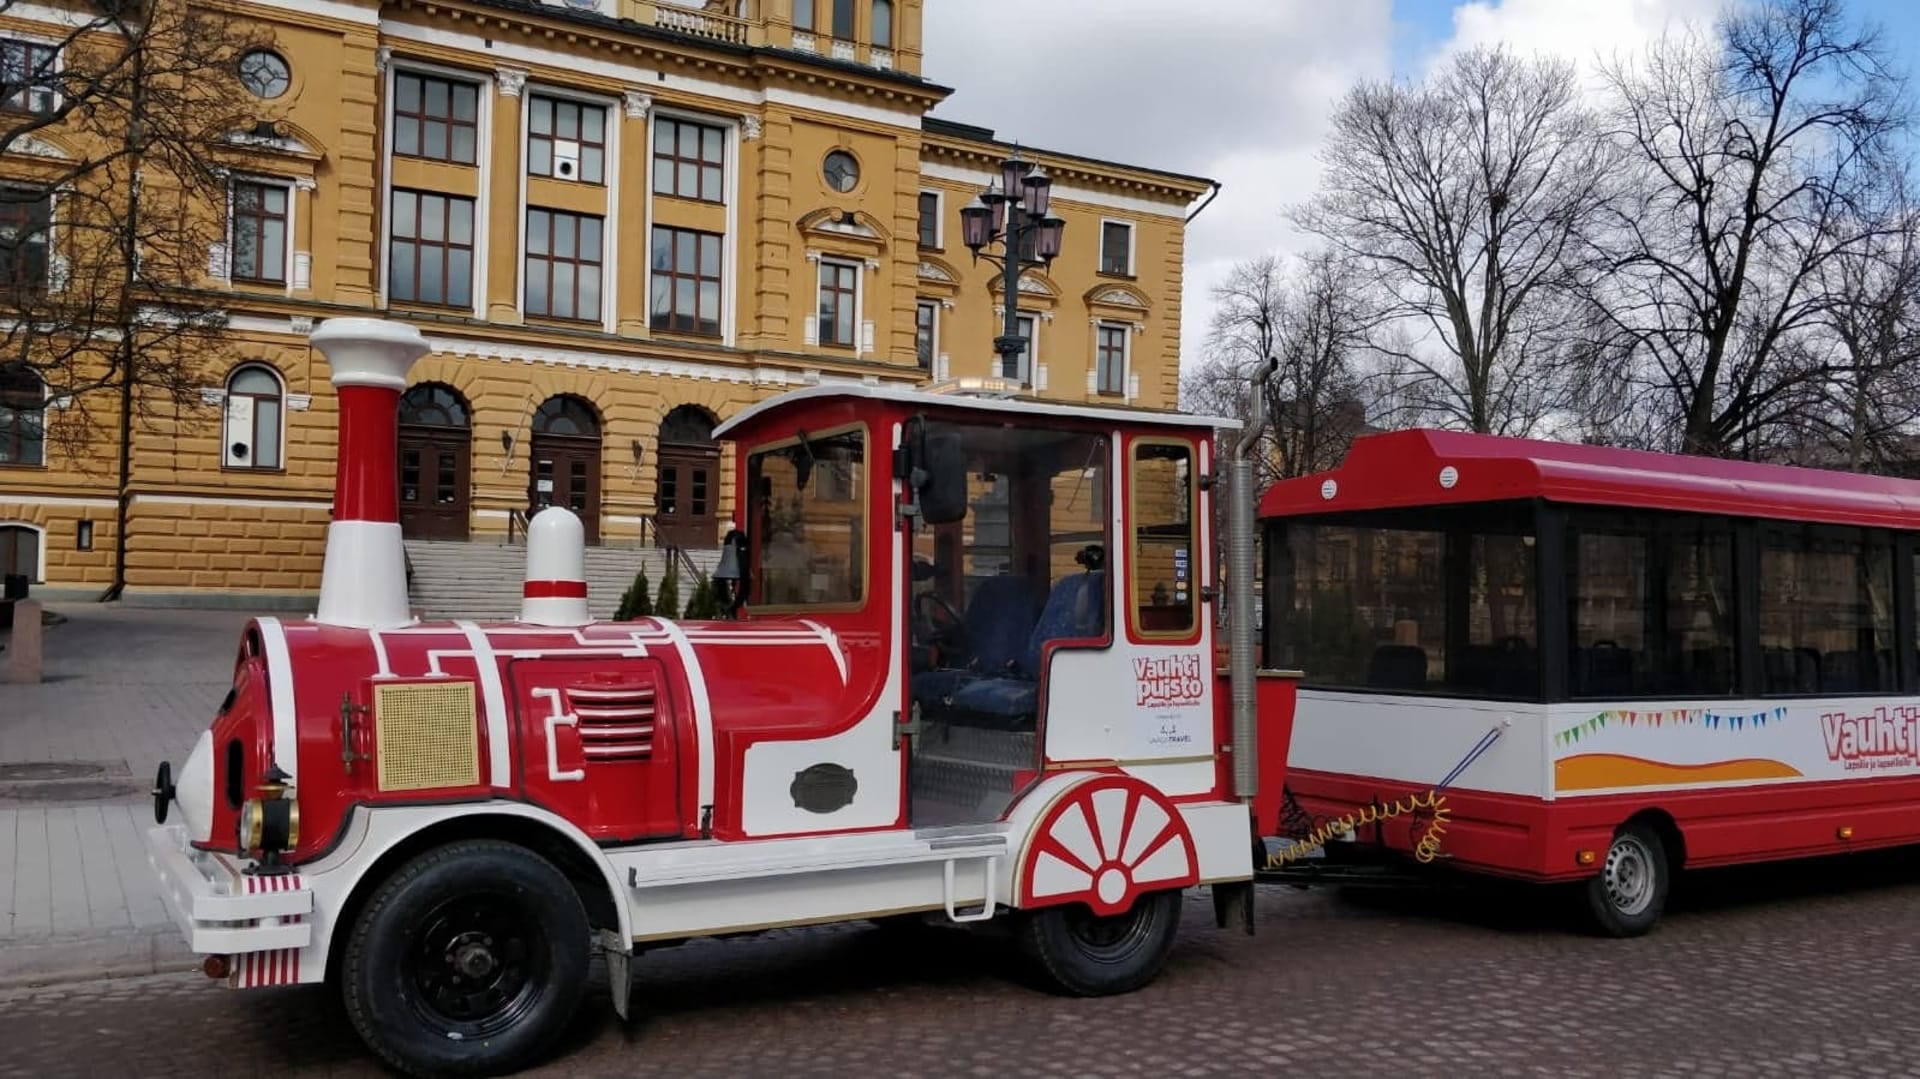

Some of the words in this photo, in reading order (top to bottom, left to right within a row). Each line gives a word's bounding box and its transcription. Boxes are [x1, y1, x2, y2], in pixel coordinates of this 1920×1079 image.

[1132, 654, 1200, 681] Vauhti
[1136, 677, 1203, 706] puisto
[1820, 706, 1920, 766] Vauhti
